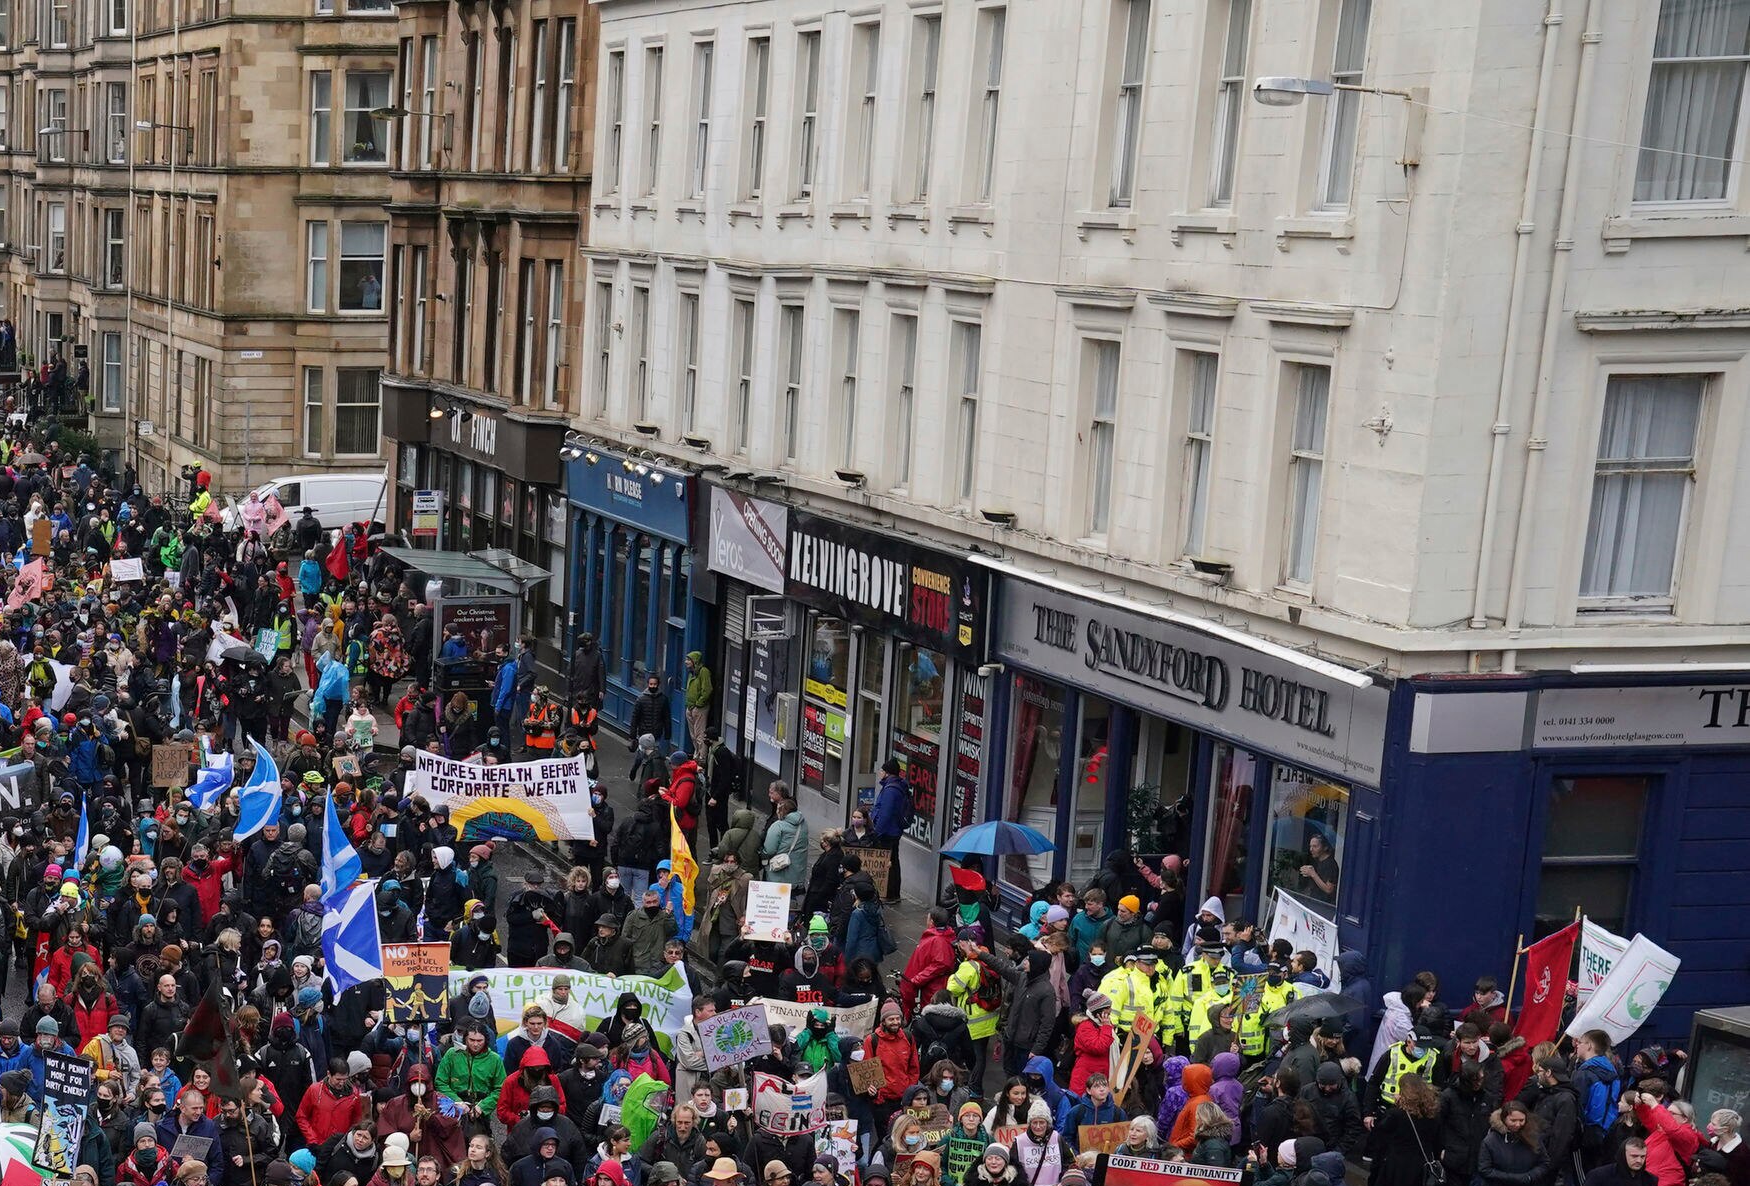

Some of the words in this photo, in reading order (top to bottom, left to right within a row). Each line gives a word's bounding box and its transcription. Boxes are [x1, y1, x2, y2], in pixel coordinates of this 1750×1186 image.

[471, 413, 496, 455] FINCH
[713, 514, 744, 572] Yeros
[743, 501, 767, 547] OPENING
[766, 536, 786, 570] SOON
[790, 531, 903, 618] KELVINGROVE
[912, 565, 951, 594] CONVENIENCE
[468, 608, 495, 616] Christmas
[912, 587, 951, 634] STORE
[1033, 603, 1078, 654] THE
[1085, 618, 1231, 713] SANDYFORD
[1239, 666, 1335, 738] HOTEL
[1543, 718, 1556, 726] tel.
[1558, 717, 1577, 726] 0141
[1578, 717, 1593, 726] 334
[1594, 716, 1614, 725] 0000
[1541, 732, 1684, 743] www.sandyfordhotelglasgow.com
[481, 767, 533, 782] HEALTH
[540, 761, 581, 779] BEFORE
[431, 777, 510, 798] CORPORATE
[523, 780, 577, 797] WEALTH
[385, 945, 409, 959] NO
[411, 950, 429, 958] NEW
[417, 958, 438, 966] FUEL
[407, 965, 444, 973] PROJECTS
[504, 974, 525, 989] TO
[611, 977, 675, 1006] CHANGE
[796, 990, 824, 1003] BIG
[704, 1023, 716, 1037] NO
[716, 1011, 760, 1026] PLANET
[712, 1054, 727, 1063] NO
[733, 1037, 763, 1062] PARTY
[46, 1057, 59, 1068] NOT
[60, 1061, 65, 1069] A
[68, 1062, 89, 1074] PENNY
[50, 1070, 65, 1082] MORE
[69, 1074, 83, 1085] FOR
[758, 1078, 806, 1096] ALL
[45, 1079, 61, 1091] DIRTY
[62, 1084, 88, 1098] ENERGY
[1111, 1157, 1137, 1169] CODE
[1139, 1161, 1160, 1171] RED
[1162, 1164, 1182, 1174] FOR
[1186, 1167, 1240, 1180] HUMANITY
